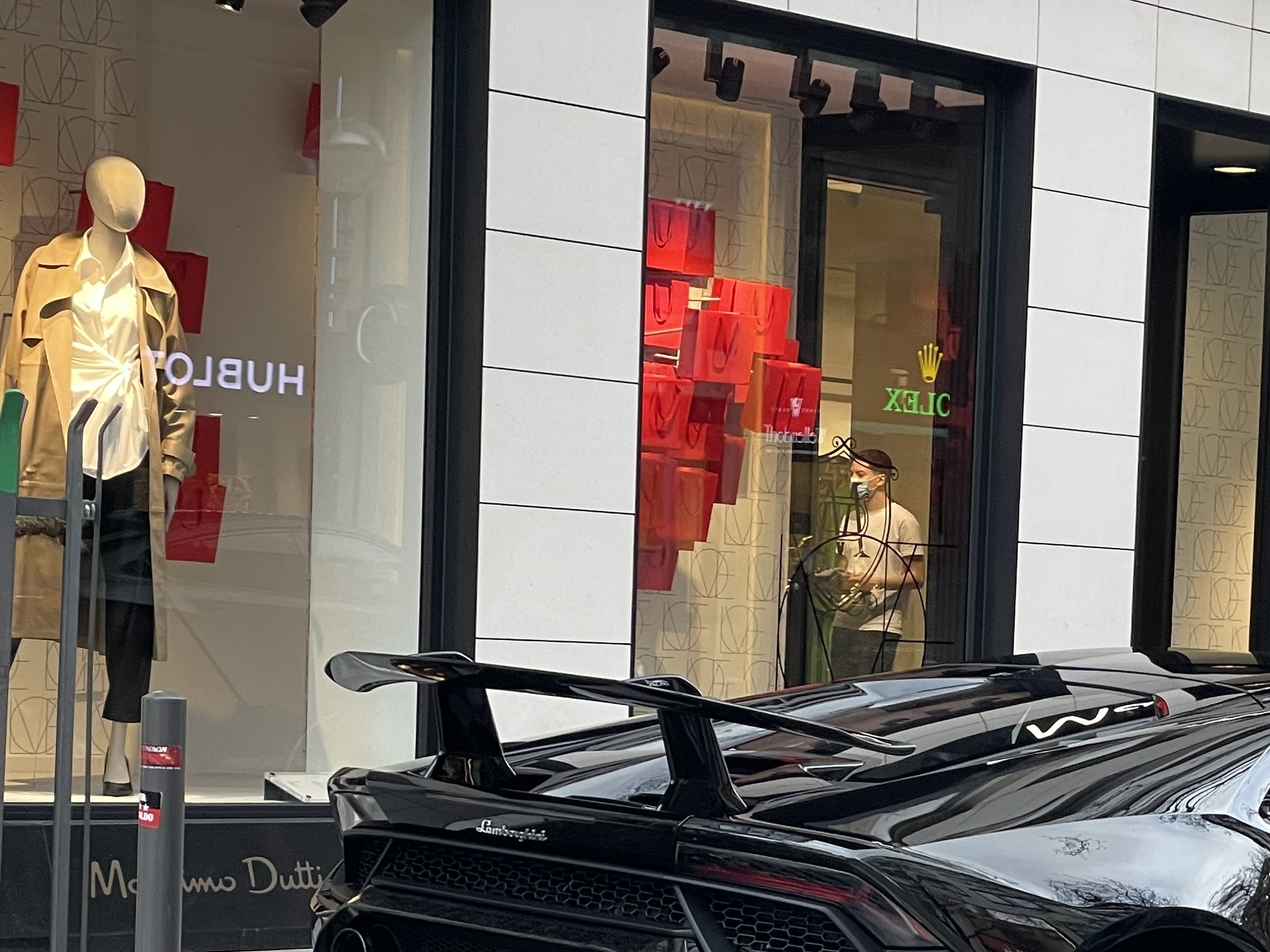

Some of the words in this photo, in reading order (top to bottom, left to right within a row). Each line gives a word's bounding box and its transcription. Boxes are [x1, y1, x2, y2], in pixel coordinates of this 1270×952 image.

[475, 819, 548, 842] Lamborghini
[91, 859, 237, 899] Mamo
[241, 856, 323, 895] Dutti
